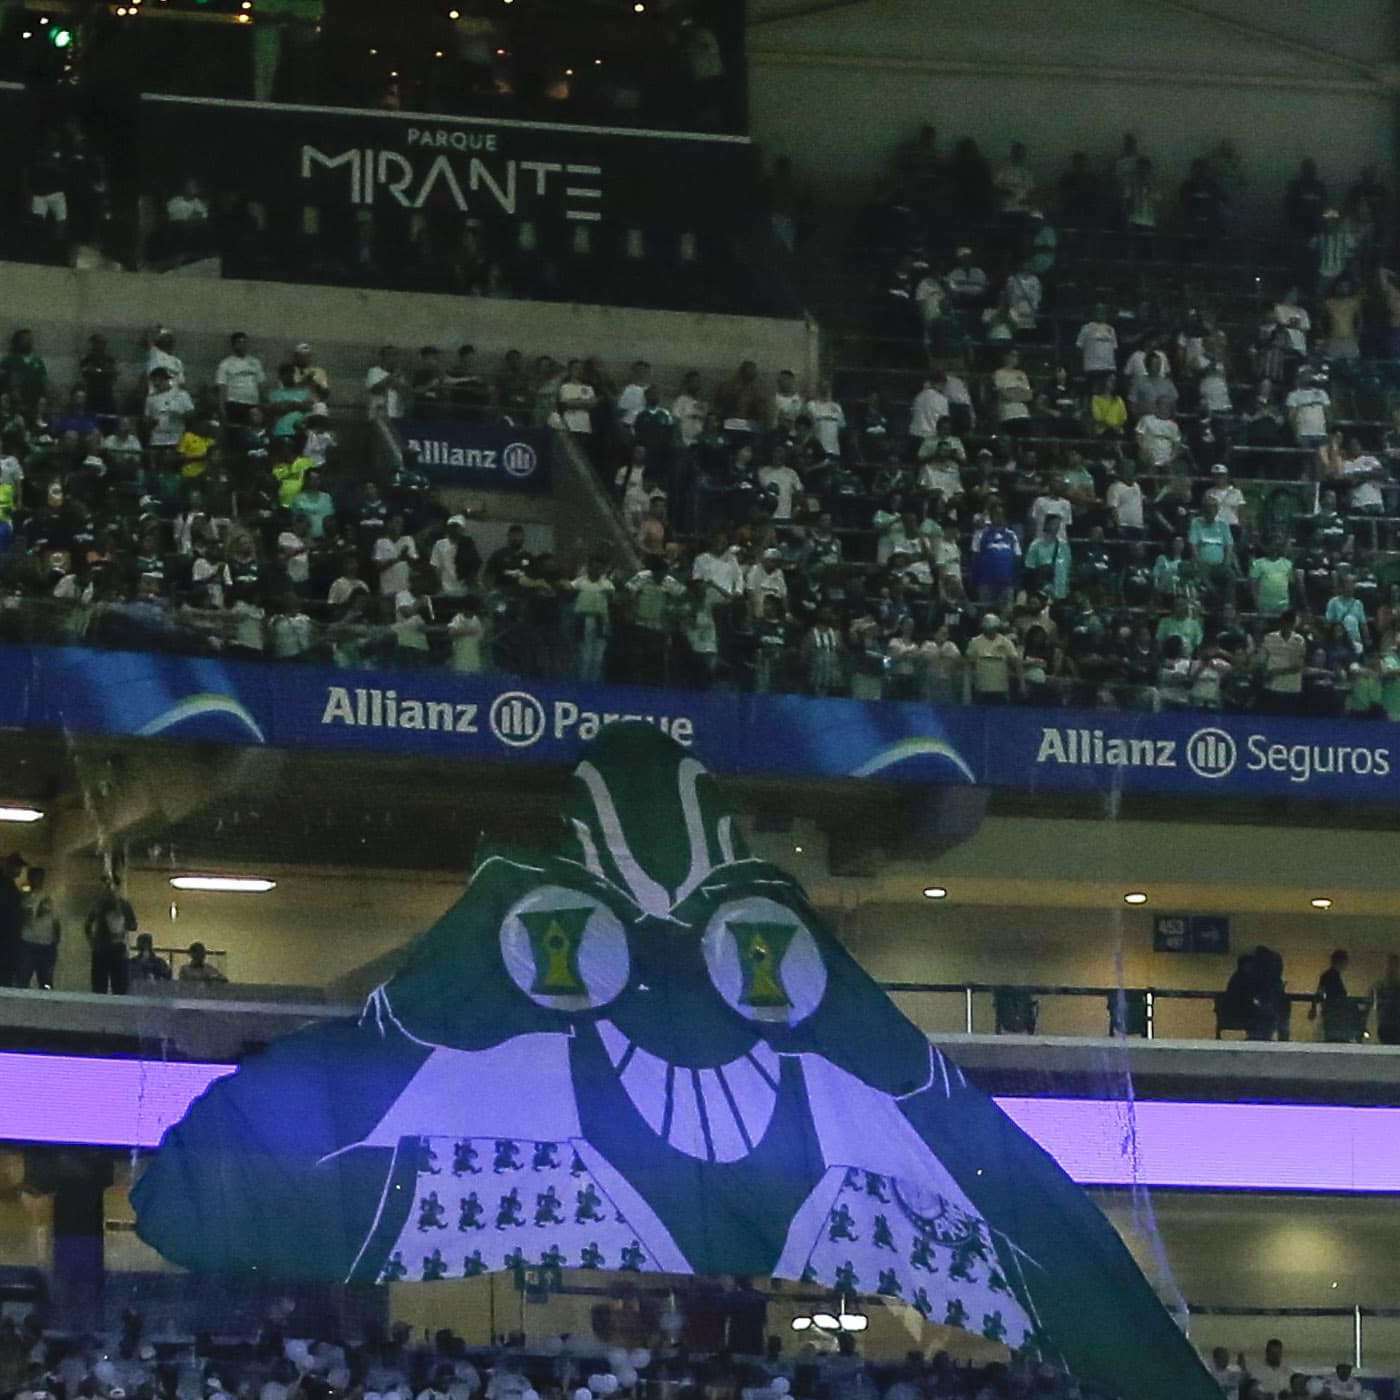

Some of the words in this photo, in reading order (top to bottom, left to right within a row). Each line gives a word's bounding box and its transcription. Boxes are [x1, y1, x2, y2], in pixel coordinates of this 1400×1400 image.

[406, 127, 499, 153] PARQUE
[301, 144, 602, 222] MIRANTE
[322, 686, 479, 735] Allianz
[1037, 727, 1177, 768] Allianz
[1247, 735, 1390, 783] Seguros
